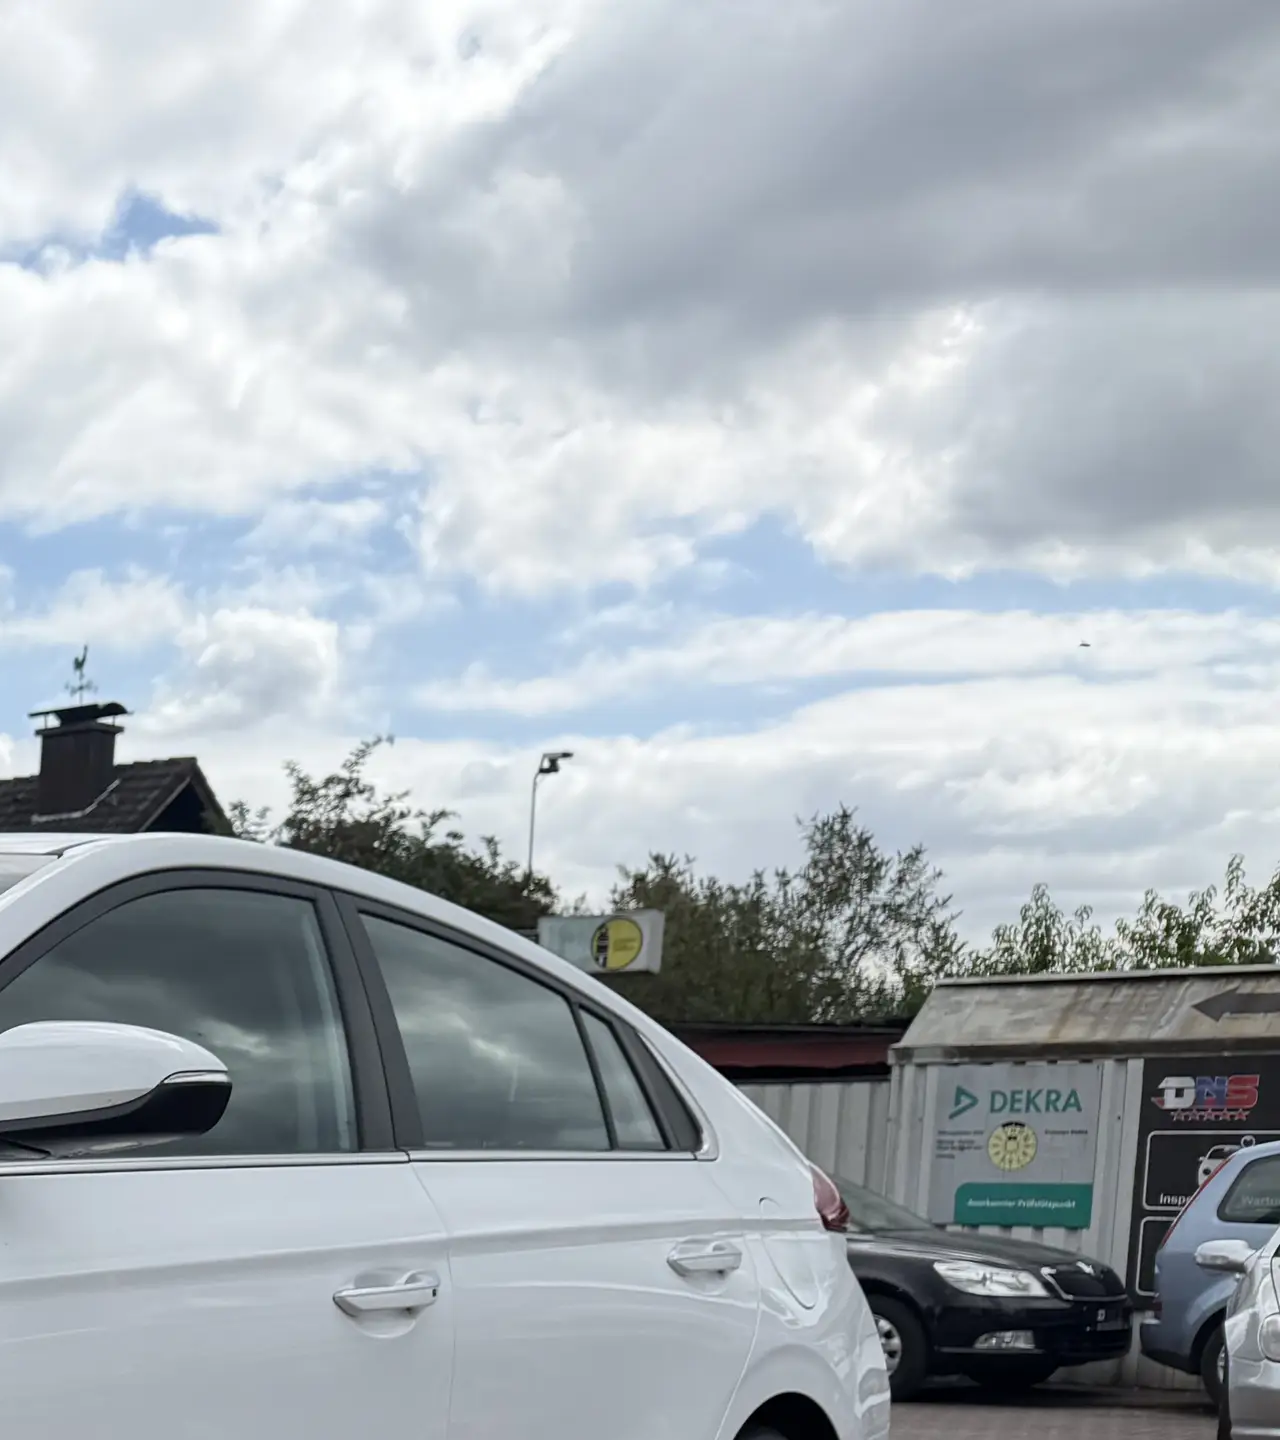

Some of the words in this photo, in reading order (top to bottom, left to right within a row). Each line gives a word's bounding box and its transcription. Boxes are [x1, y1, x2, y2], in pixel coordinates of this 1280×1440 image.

[990, 1088, 1083, 1114] DEKRA
[1158, 1074, 1260, 1110] DNS
[1241, 1194, 1280, 1207] Wartu
